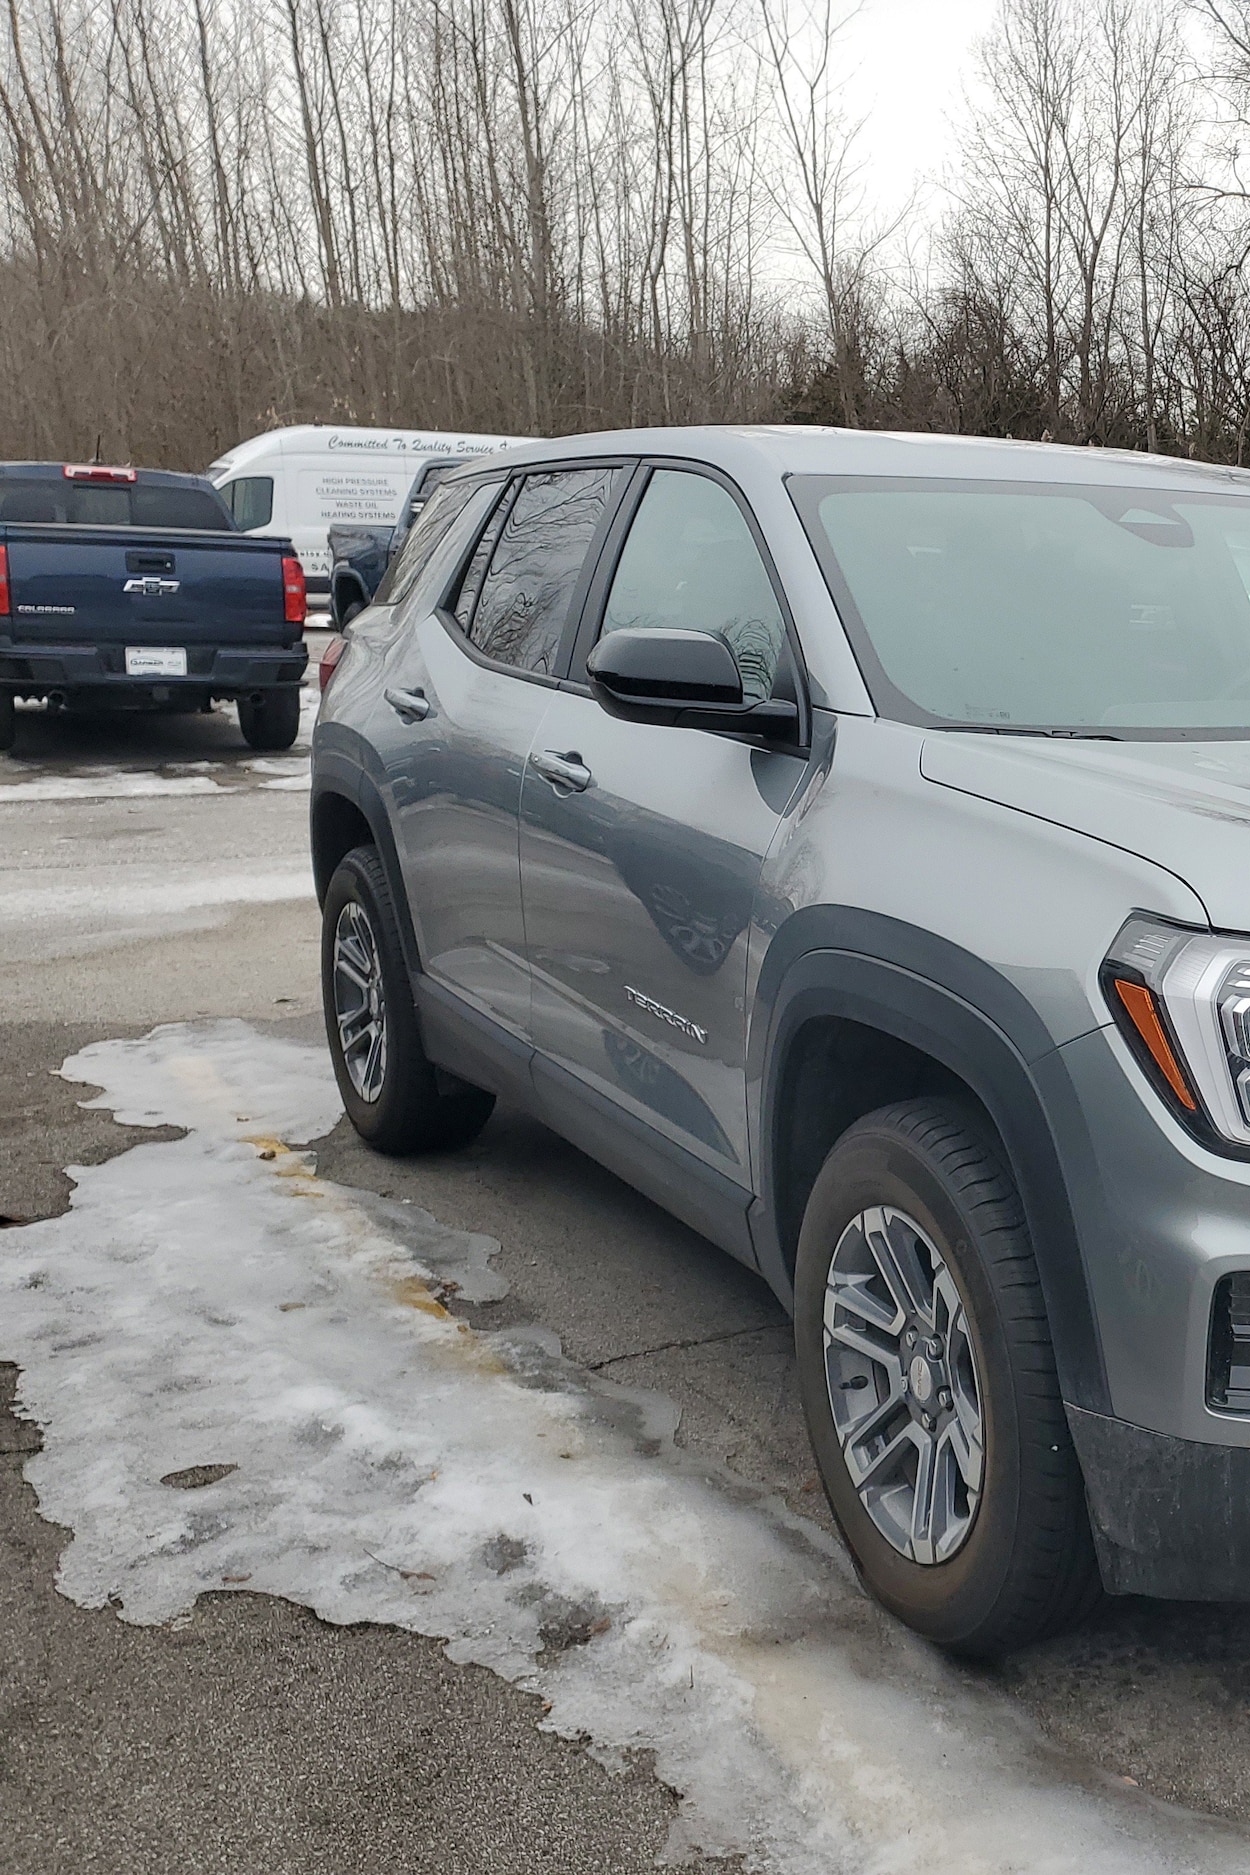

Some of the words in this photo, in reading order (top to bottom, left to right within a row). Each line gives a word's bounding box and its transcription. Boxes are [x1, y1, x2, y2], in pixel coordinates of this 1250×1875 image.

[328, 434, 388, 450] Committed
[393, 438, 406, 450] To
[412, 438, 452, 454] Quality
[456, 440, 494, 455] Service
[322, 477, 343, 485] HIGH
[345, 478, 388, 486] PRESSURE
[315, 487, 358, 495] CLEANING
[359, 488, 398, 496] SYSTEMS
[336, 501, 362, 509] WASTE
[365, 501, 378, 509] OIL
[358, 511, 396, 519] SYSTEMS
[623, 985, 708, 1045] TERRAIN
